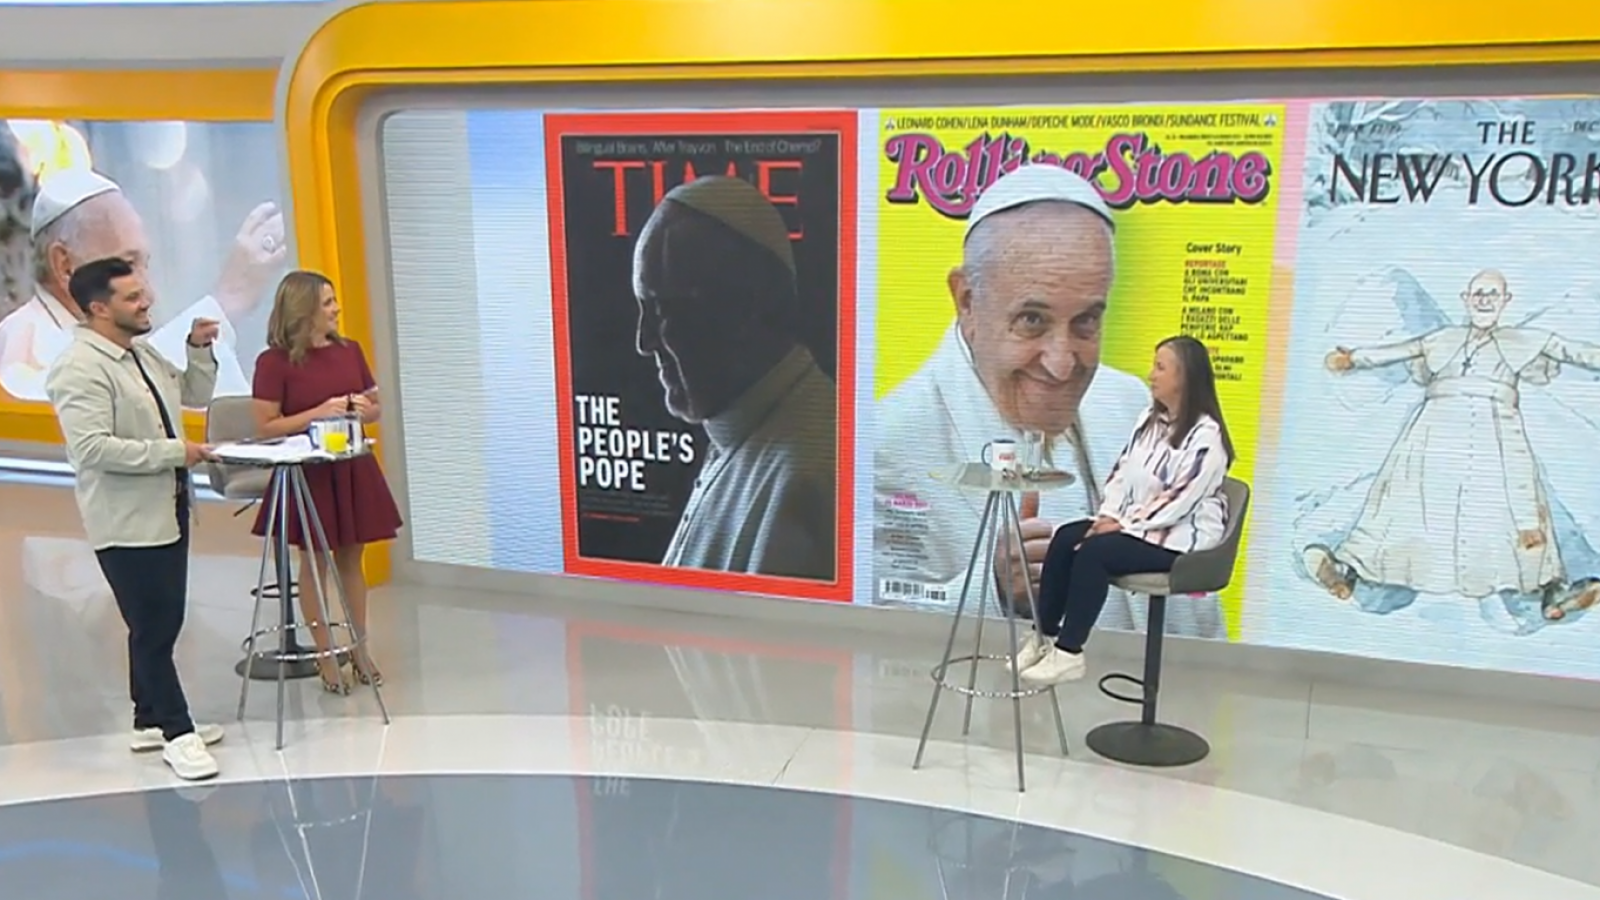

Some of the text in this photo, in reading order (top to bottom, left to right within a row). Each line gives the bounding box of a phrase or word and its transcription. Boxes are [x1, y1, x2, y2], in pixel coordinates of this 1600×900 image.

[896, 117, 934, 130] LEONARD
[1219, 113, 1260, 126] FESTIVAL
[1477, 121, 1536, 145] THE
[1093, 132, 1271, 209] Stone
[1330, 153, 1454, 204] NEW
[1187, 242, 1242, 256] Cover Story
[575, 395, 621, 426] THE
[578, 426, 694, 464] PEOPLE'S
[579, 456, 646, 491] POPE
